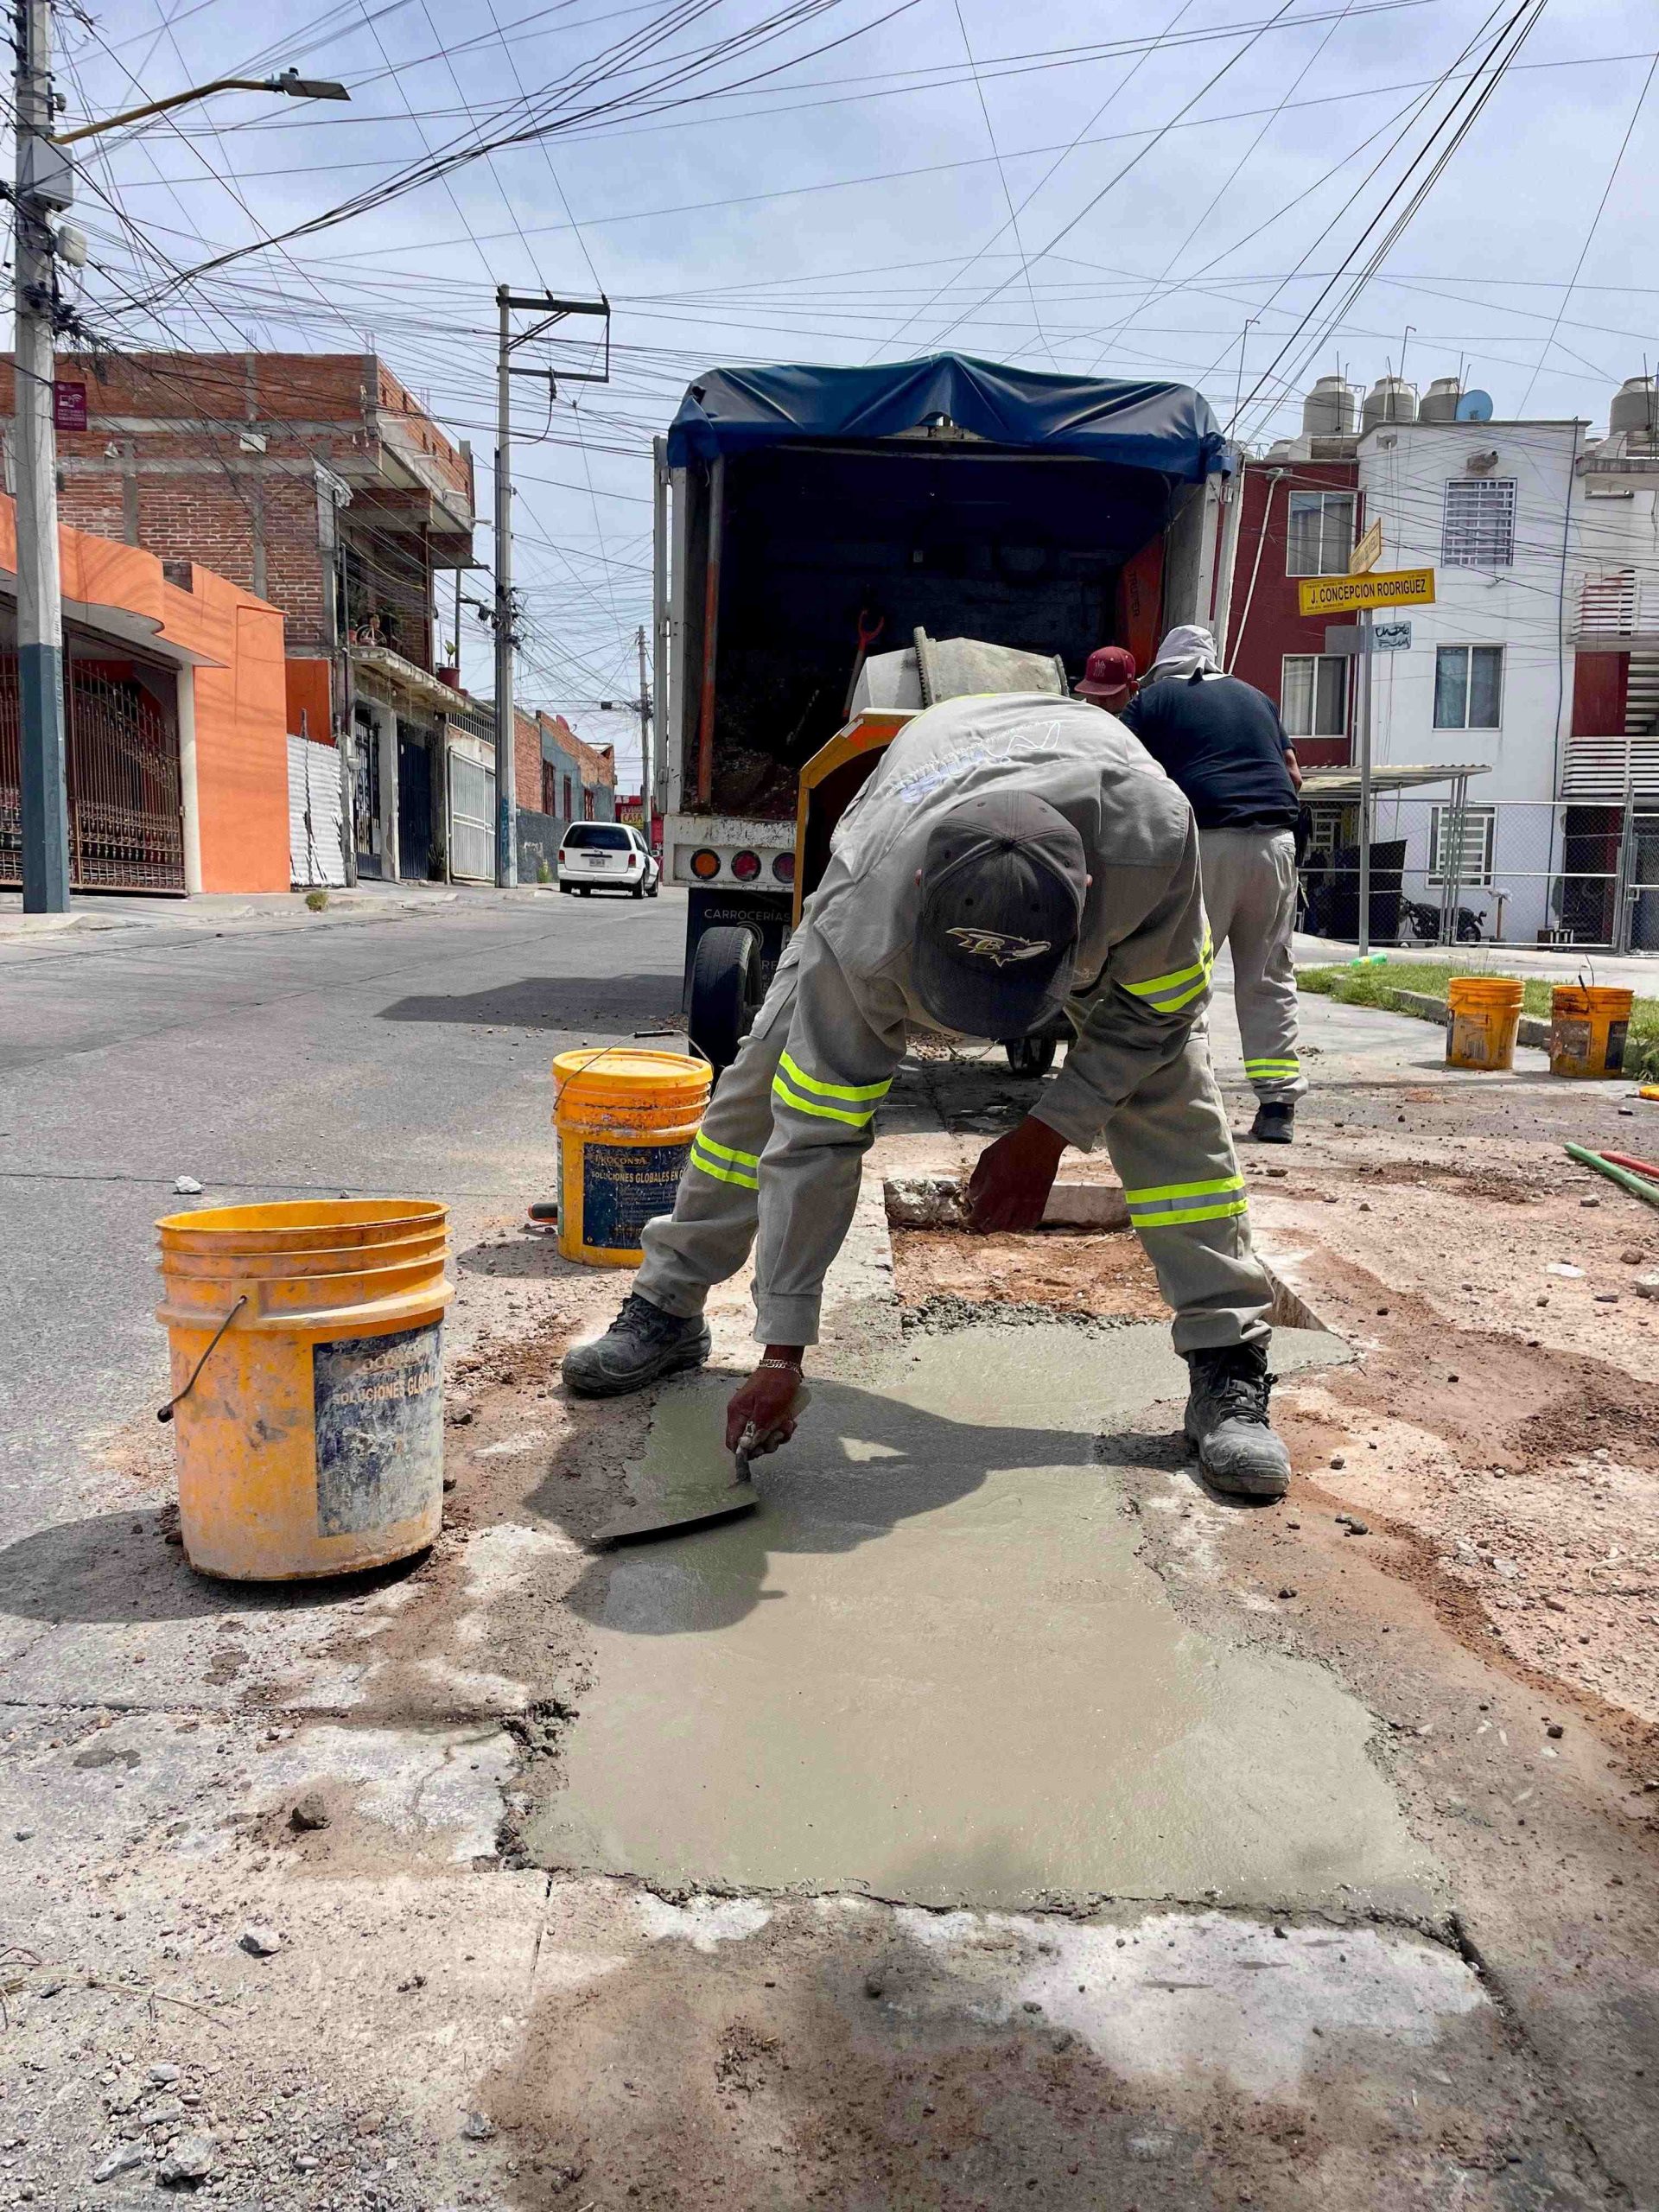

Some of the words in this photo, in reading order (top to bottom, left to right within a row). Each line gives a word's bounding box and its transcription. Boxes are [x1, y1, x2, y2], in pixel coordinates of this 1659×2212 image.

[1311, 588, 1319, 604] J.
[1319, 584, 1375, 603] CONCEPCION
[1377, 578, 1427, 596] RODRIGUEZ
[622, 813, 643, 823] CASA
[591, 1171, 634, 1183] SOLUCIONES
[635, 1171, 670, 1184] GLOBALES
[671, 1170, 679, 1181] EN
[333, 1380, 405, 1405] SOLUCIONES
